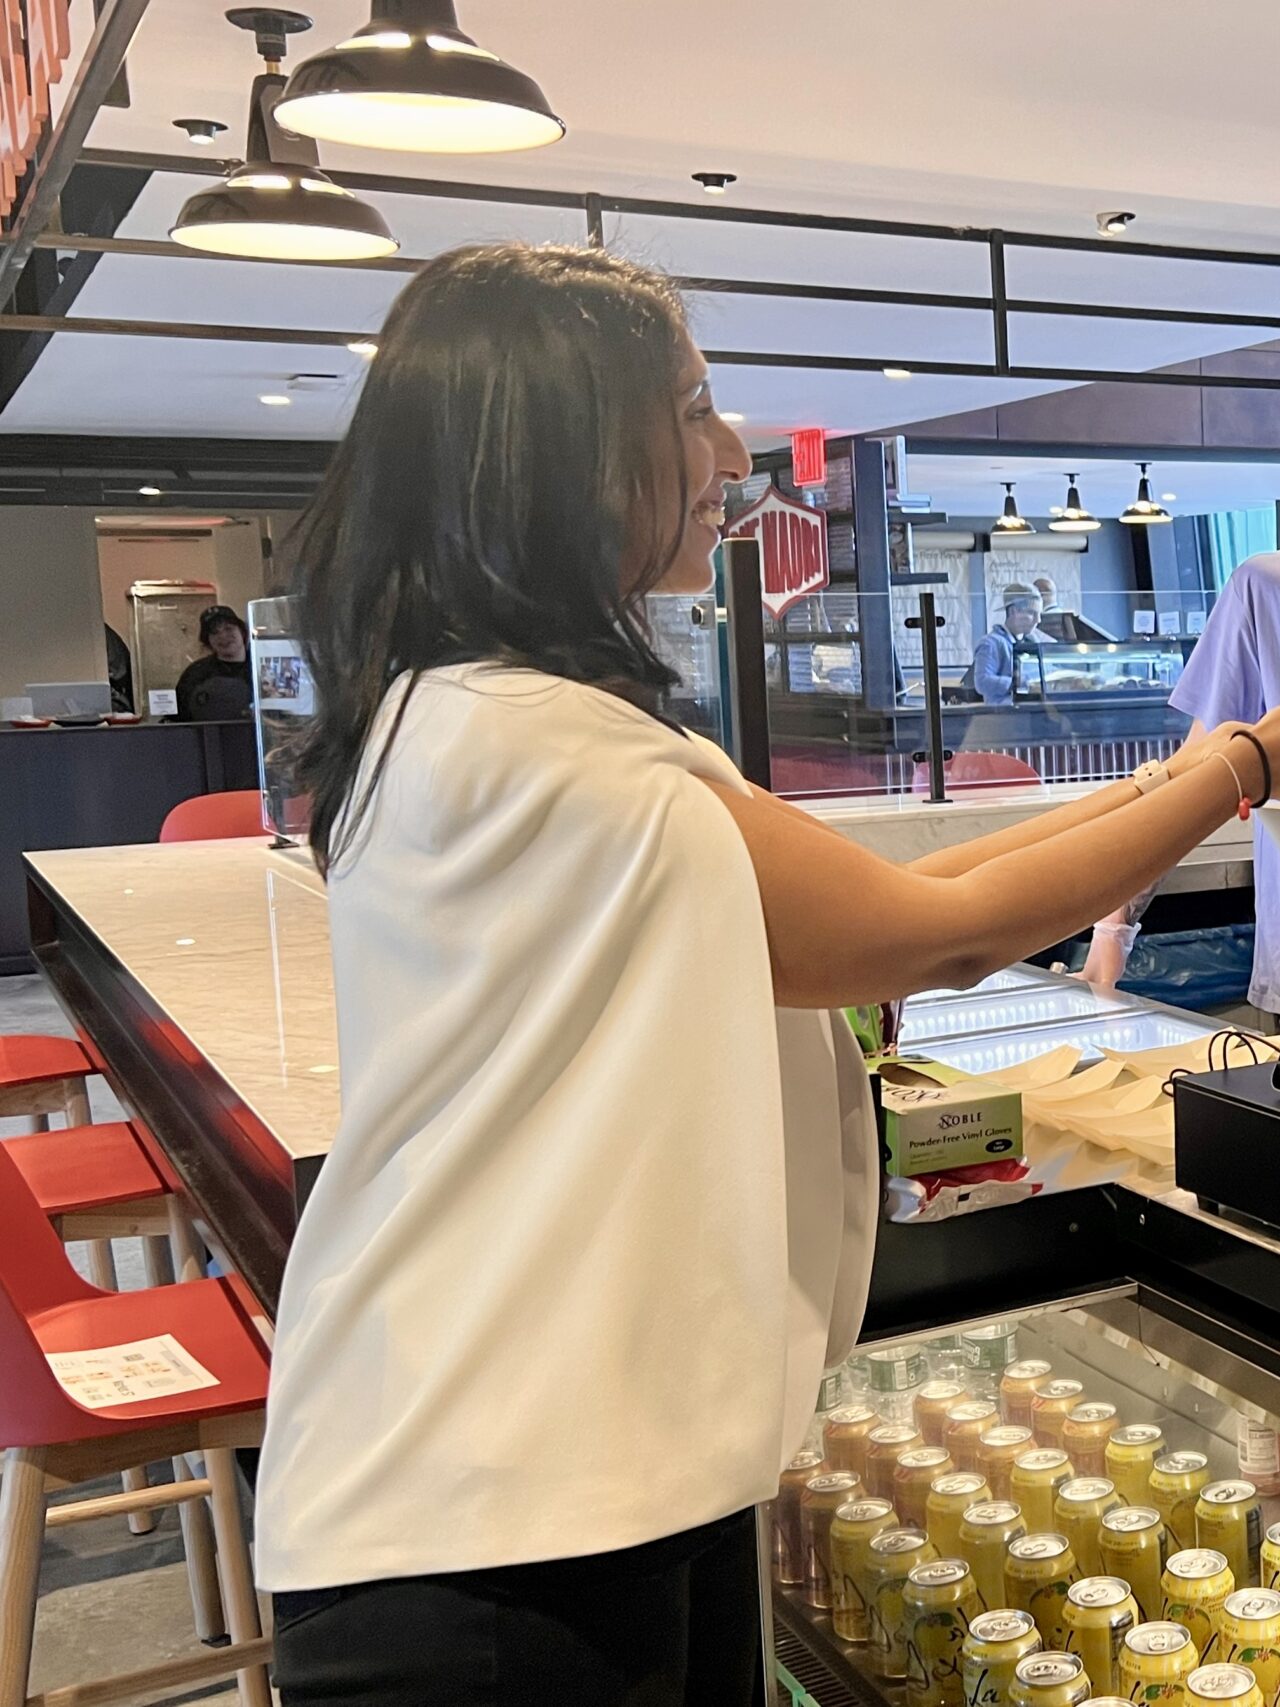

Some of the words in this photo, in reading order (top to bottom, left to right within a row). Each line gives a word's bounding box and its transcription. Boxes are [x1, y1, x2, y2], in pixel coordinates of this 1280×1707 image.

[938, 1111, 984, 1130] NOBLE
[962, 1129, 983, 1141] Vinyl
[984, 1127, 1012, 1137] Gloves
